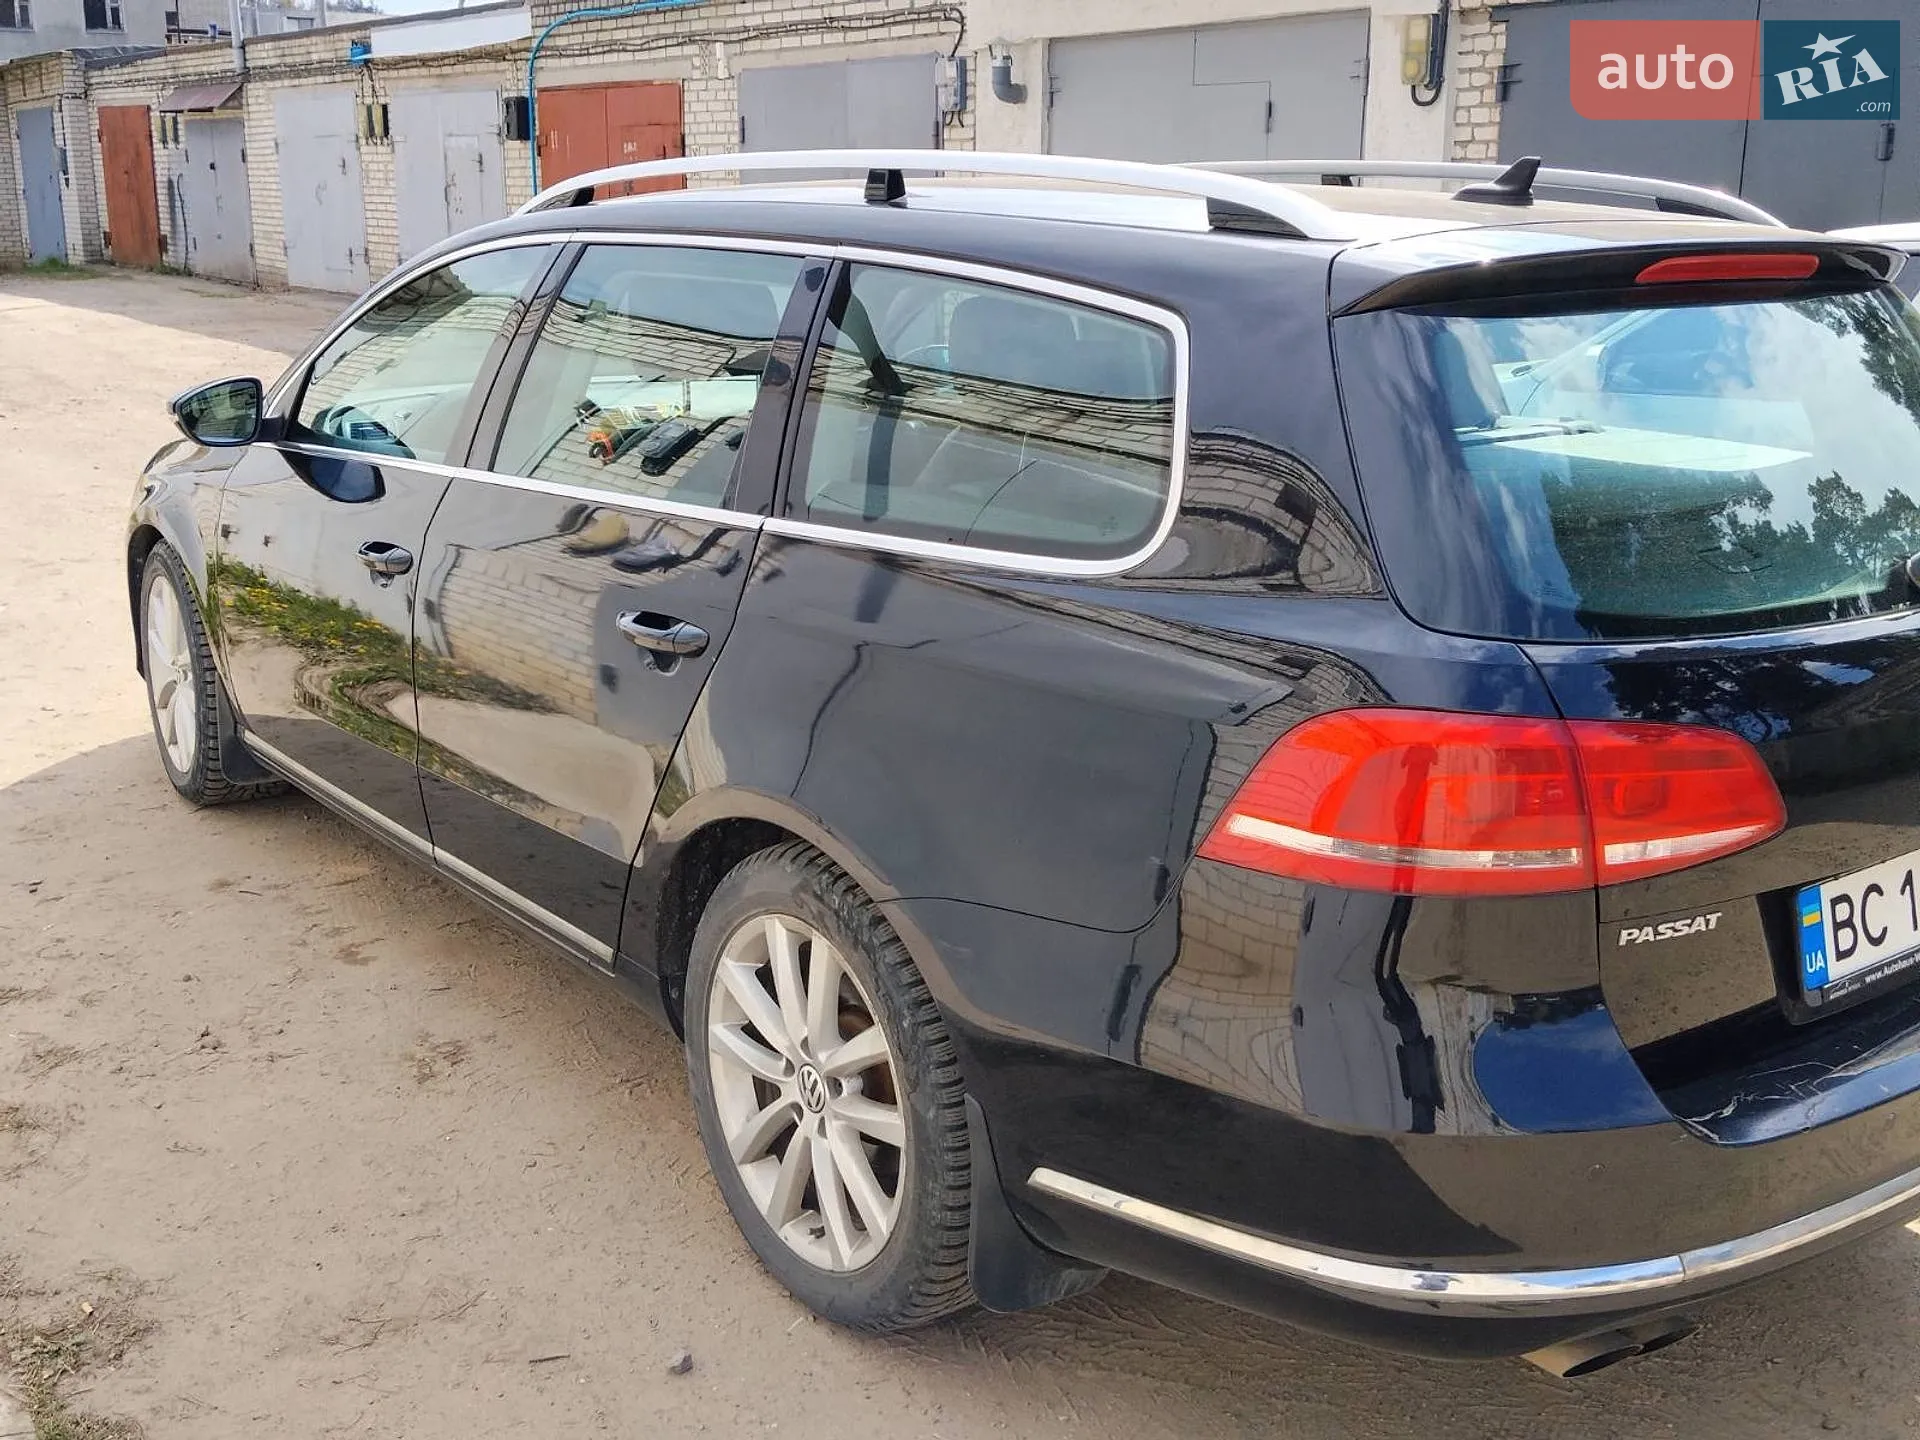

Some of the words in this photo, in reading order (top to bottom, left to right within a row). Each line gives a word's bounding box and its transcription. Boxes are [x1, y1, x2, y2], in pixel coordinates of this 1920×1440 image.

[1618, 912, 1723, 946] PASSAT
[1830, 883, 1888, 963] BC
[1900, 869, 1918, 932] 1
[1806, 949, 1825, 973] UA
